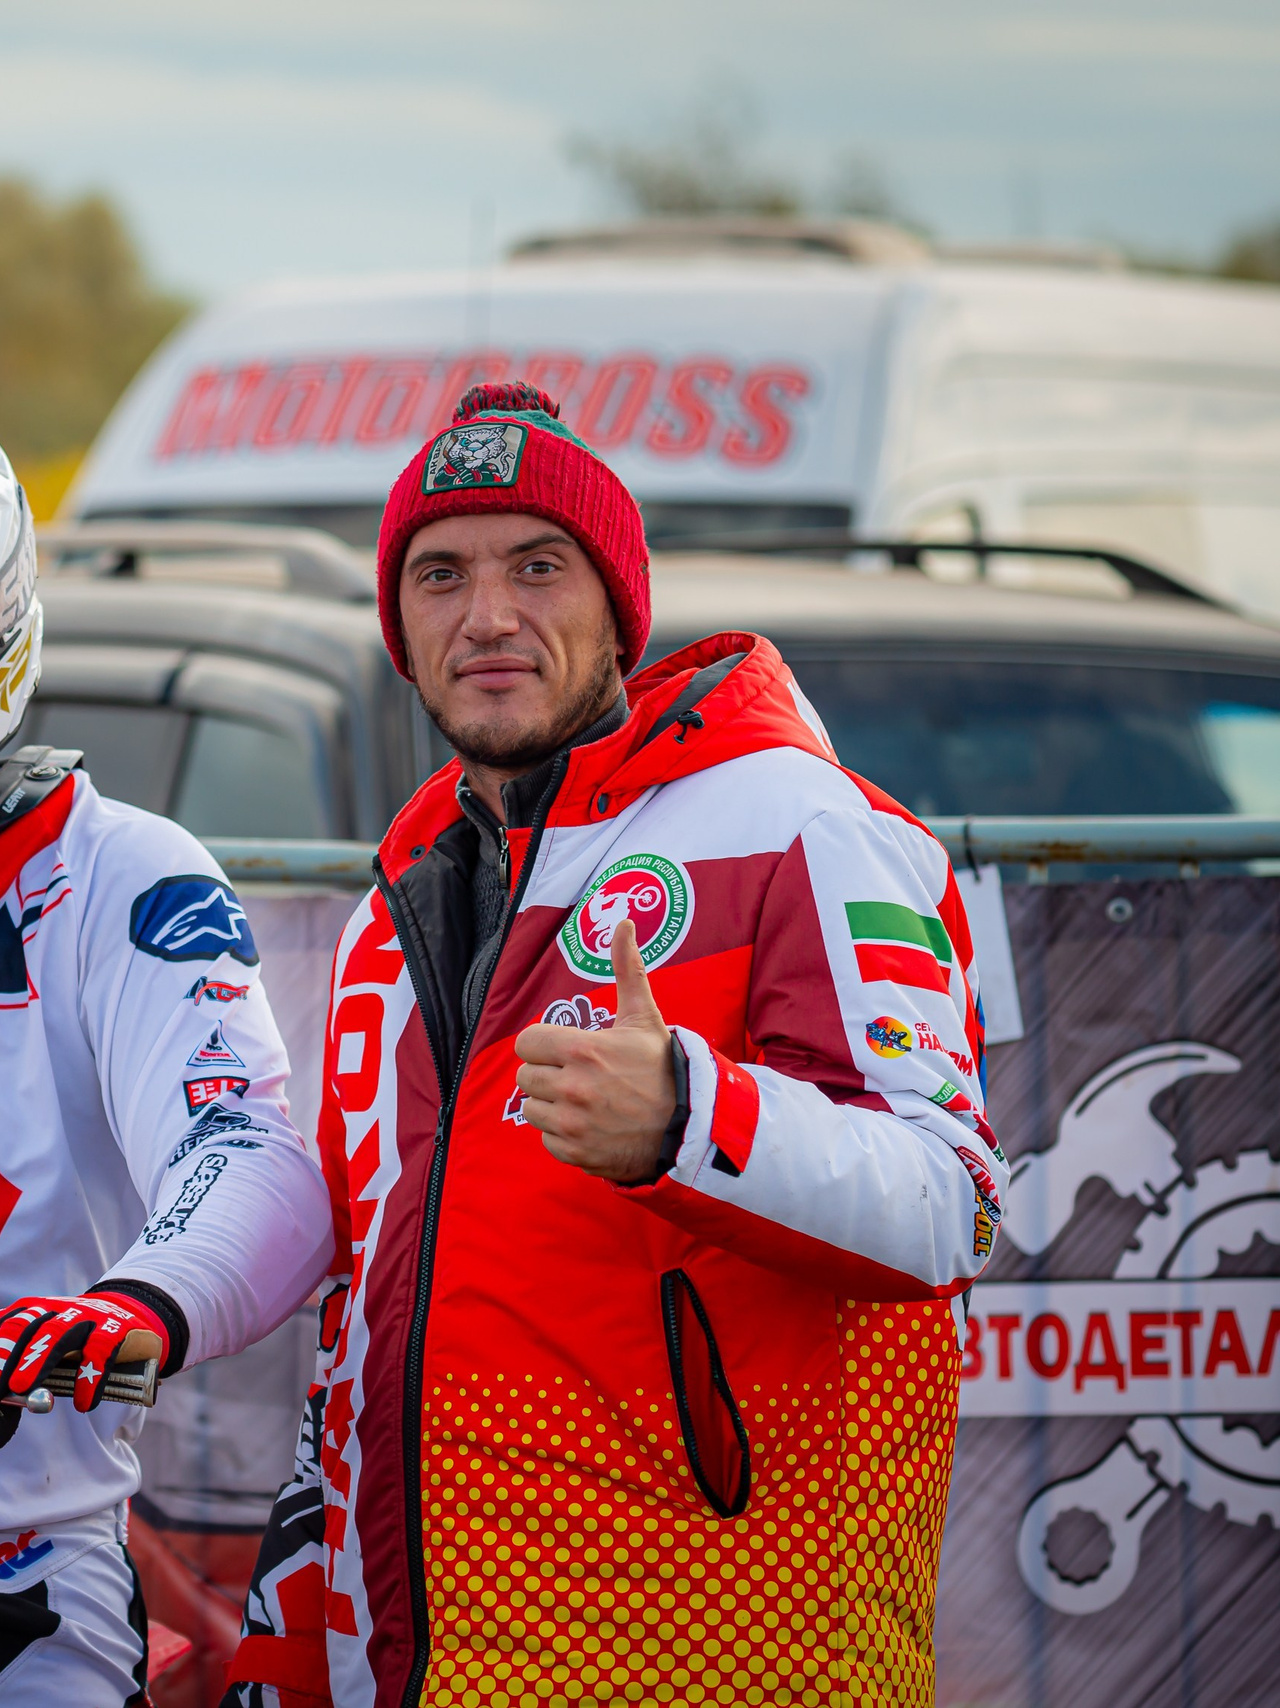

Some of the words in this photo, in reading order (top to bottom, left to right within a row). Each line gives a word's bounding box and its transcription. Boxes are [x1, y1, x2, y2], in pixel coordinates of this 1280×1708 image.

[594, 856, 653, 887] ФЕДЕРАЦИЯ
[651, 858, 685, 913] РЕСПУБЛИКИ
[642, 915, 682, 962] ТАТАРСТА
